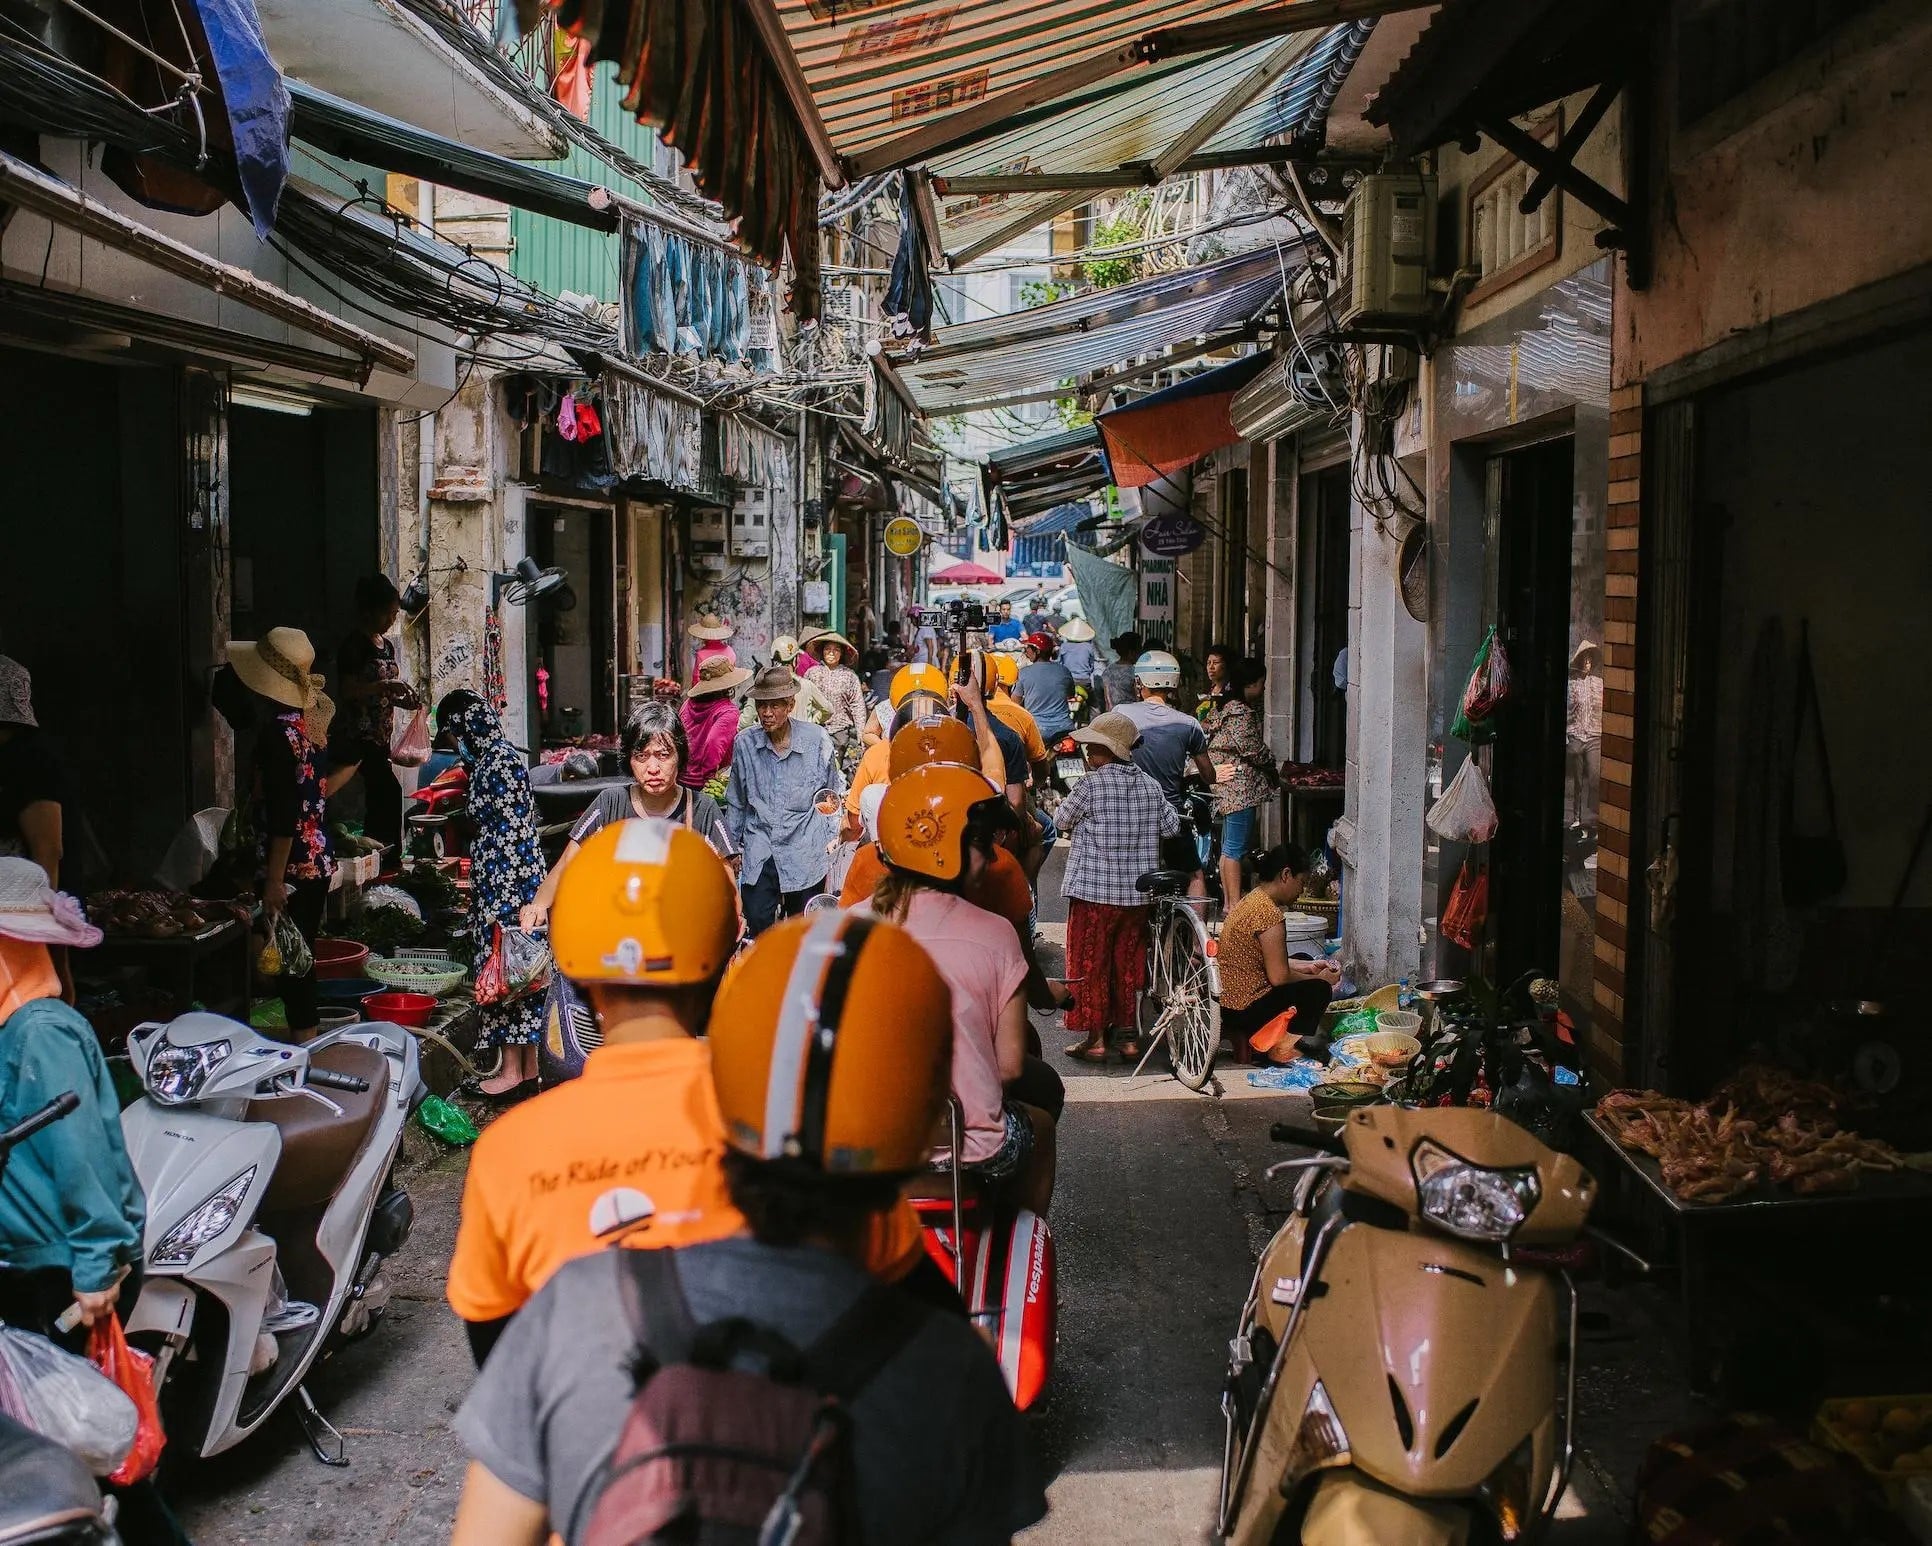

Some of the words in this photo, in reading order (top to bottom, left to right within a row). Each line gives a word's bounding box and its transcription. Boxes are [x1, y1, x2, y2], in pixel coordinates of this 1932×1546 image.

[1141, 560, 1174, 574] PHARMACY
[529, 1169, 560, 1195] The
[566, 1158, 619, 1185] Ride
[625, 1150, 651, 1176] of
[657, 1147, 714, 1170] Your
